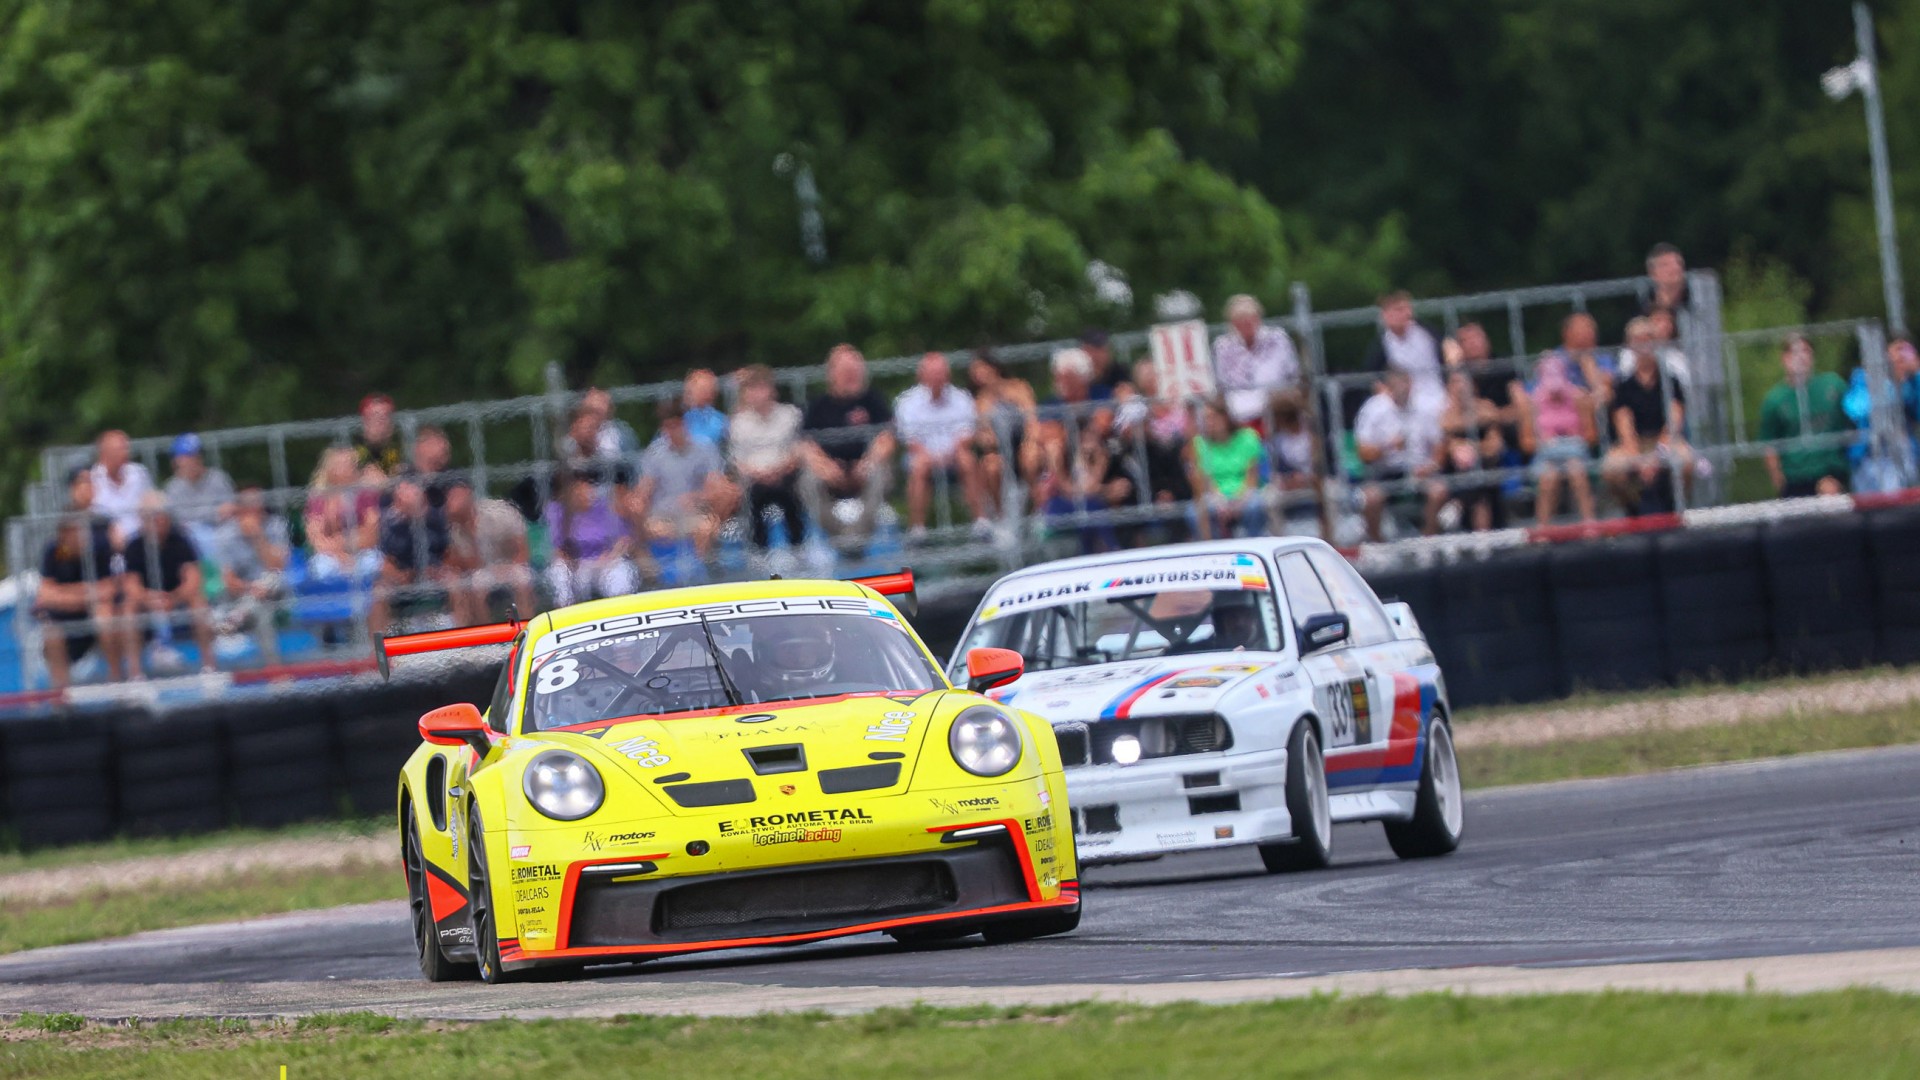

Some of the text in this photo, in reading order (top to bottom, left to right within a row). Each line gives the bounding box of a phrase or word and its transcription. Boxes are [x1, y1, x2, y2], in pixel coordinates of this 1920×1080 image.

[556, 599, 869, 644] PORSCHE
[556, 630, 660, 660] Zagórski
[536, 658, 580, 695] 8
[719, 725, 808, 739] FLAVA
[864, 711, 917, 742] Nice
[606, 735, 671, 768] Nice
[957, 797, 999, 808] motors
[609, 831, 656, 842] motors
[720, 825, 775, 838] KOWALSTWO
[786, 819, 845, 829] AUTOMATYKA
